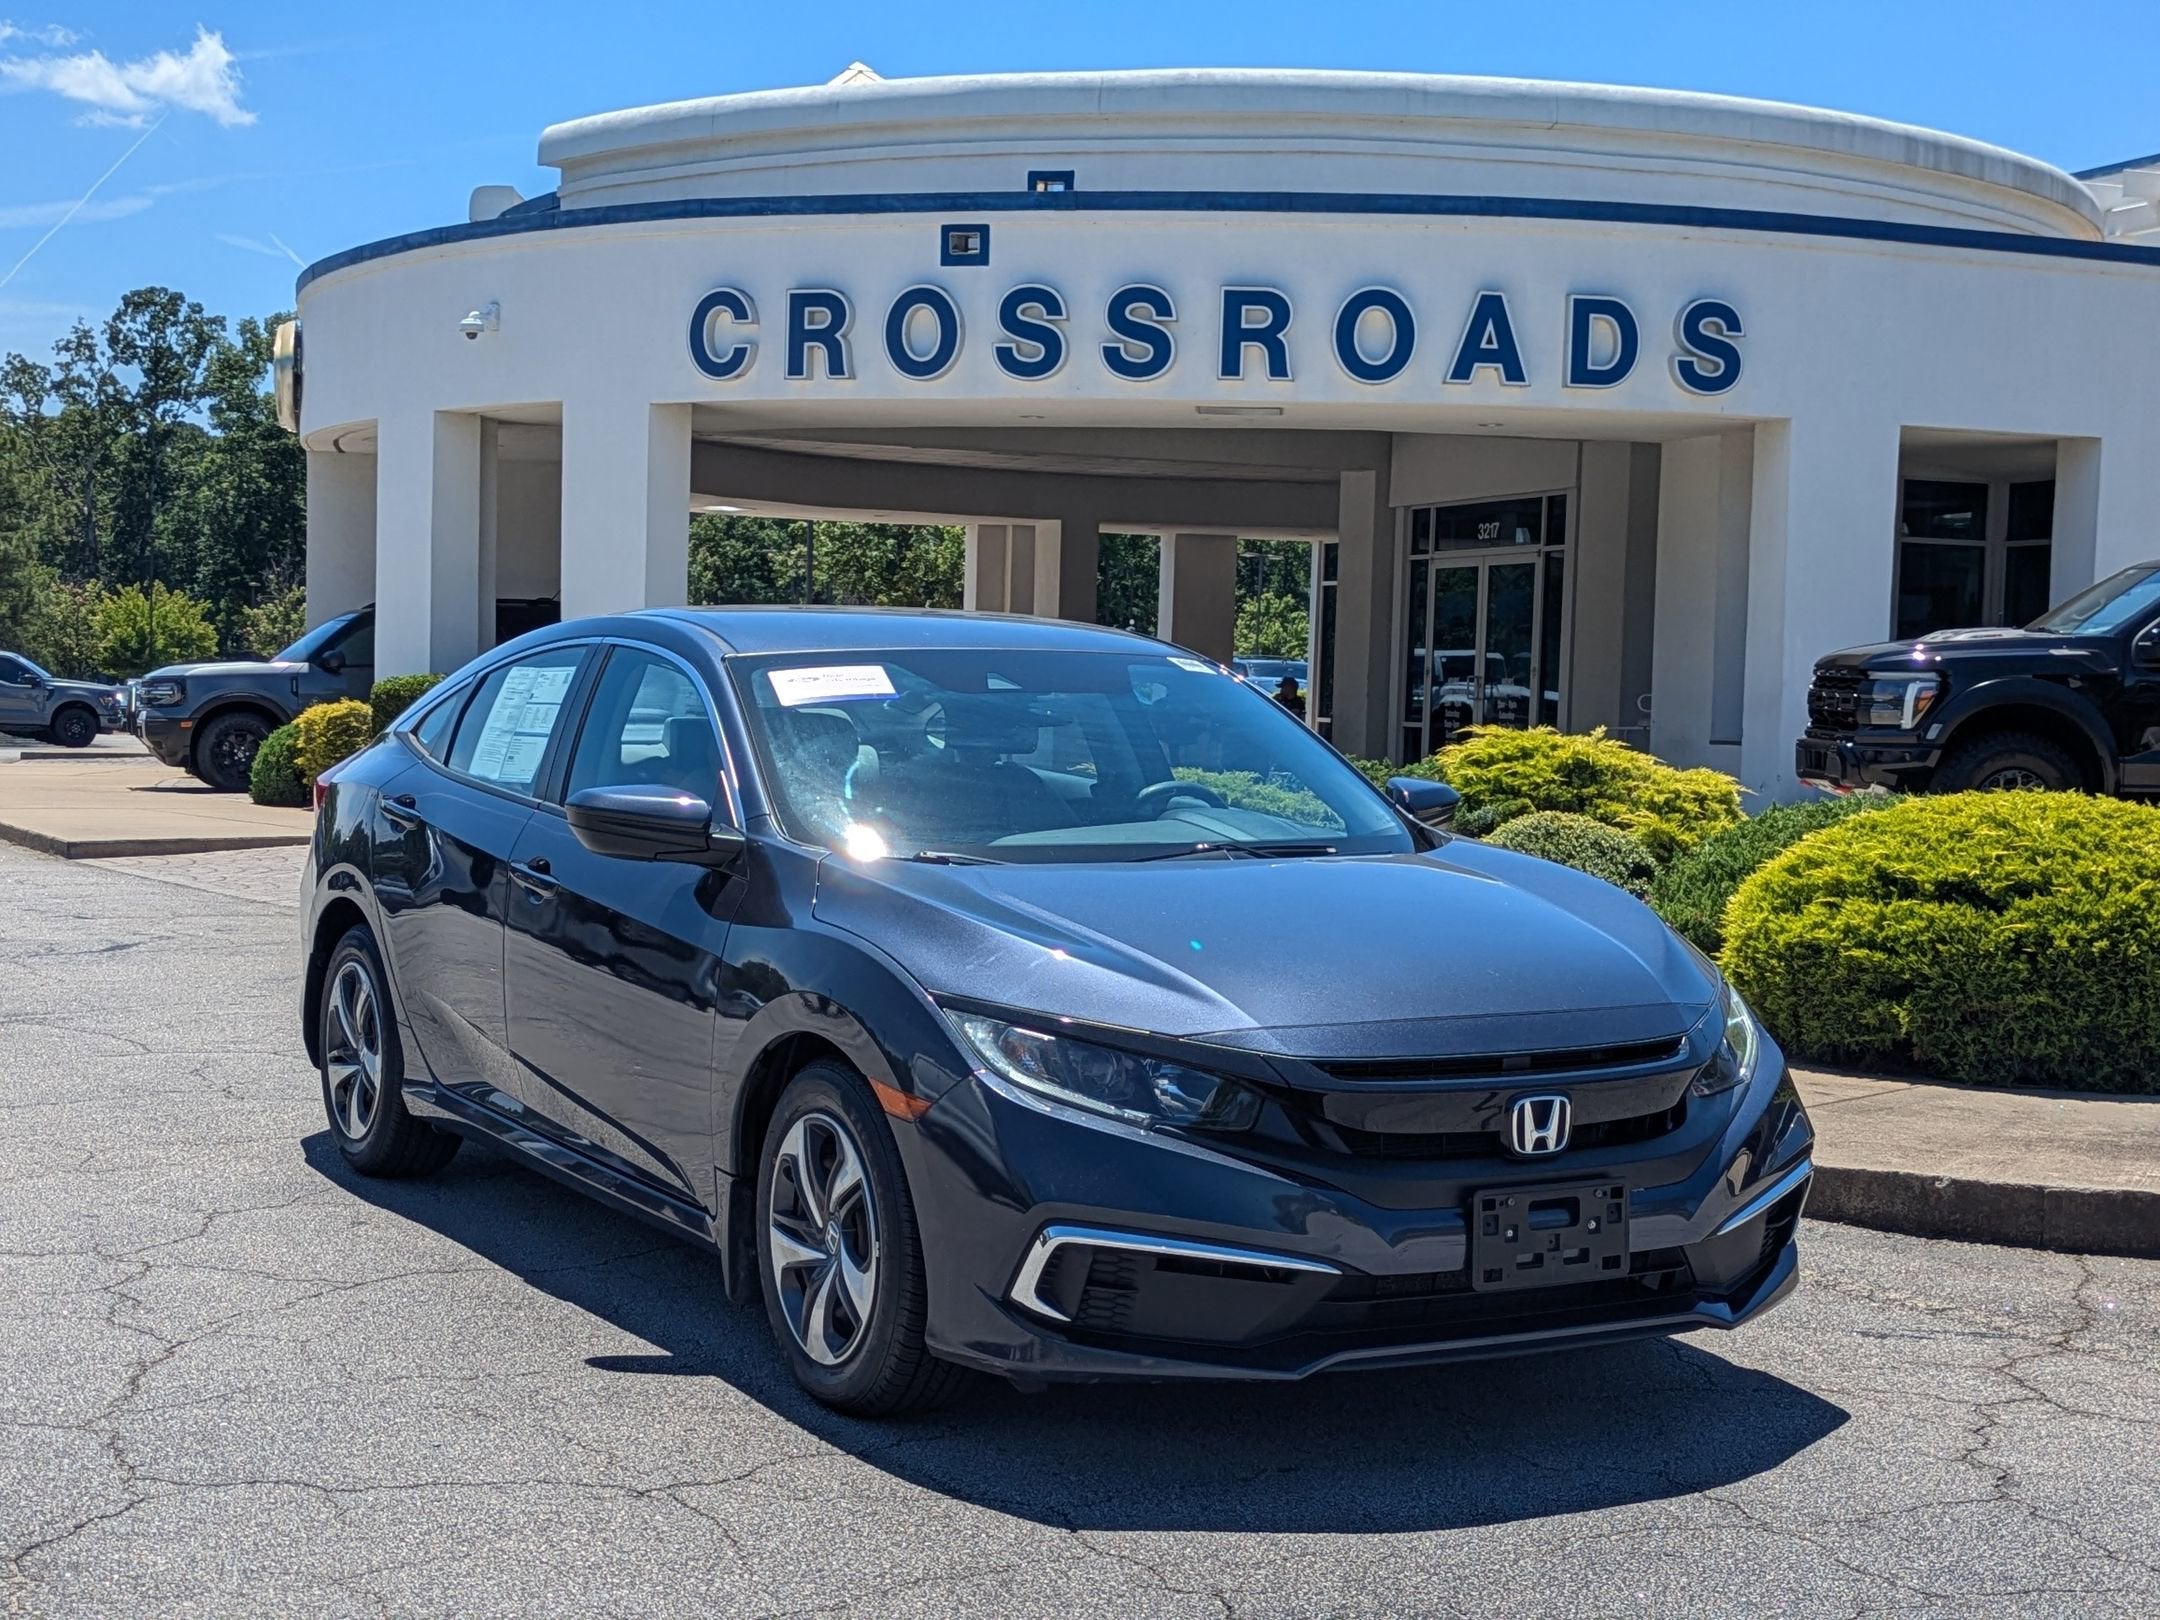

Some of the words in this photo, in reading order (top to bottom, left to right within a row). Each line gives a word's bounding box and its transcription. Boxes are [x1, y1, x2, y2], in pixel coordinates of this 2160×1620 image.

[687, 283, 1745, 396] CROSSROADS
[1477, 522, 1500, 540] 3217
[1523, 1096, 1561, 1153] H
